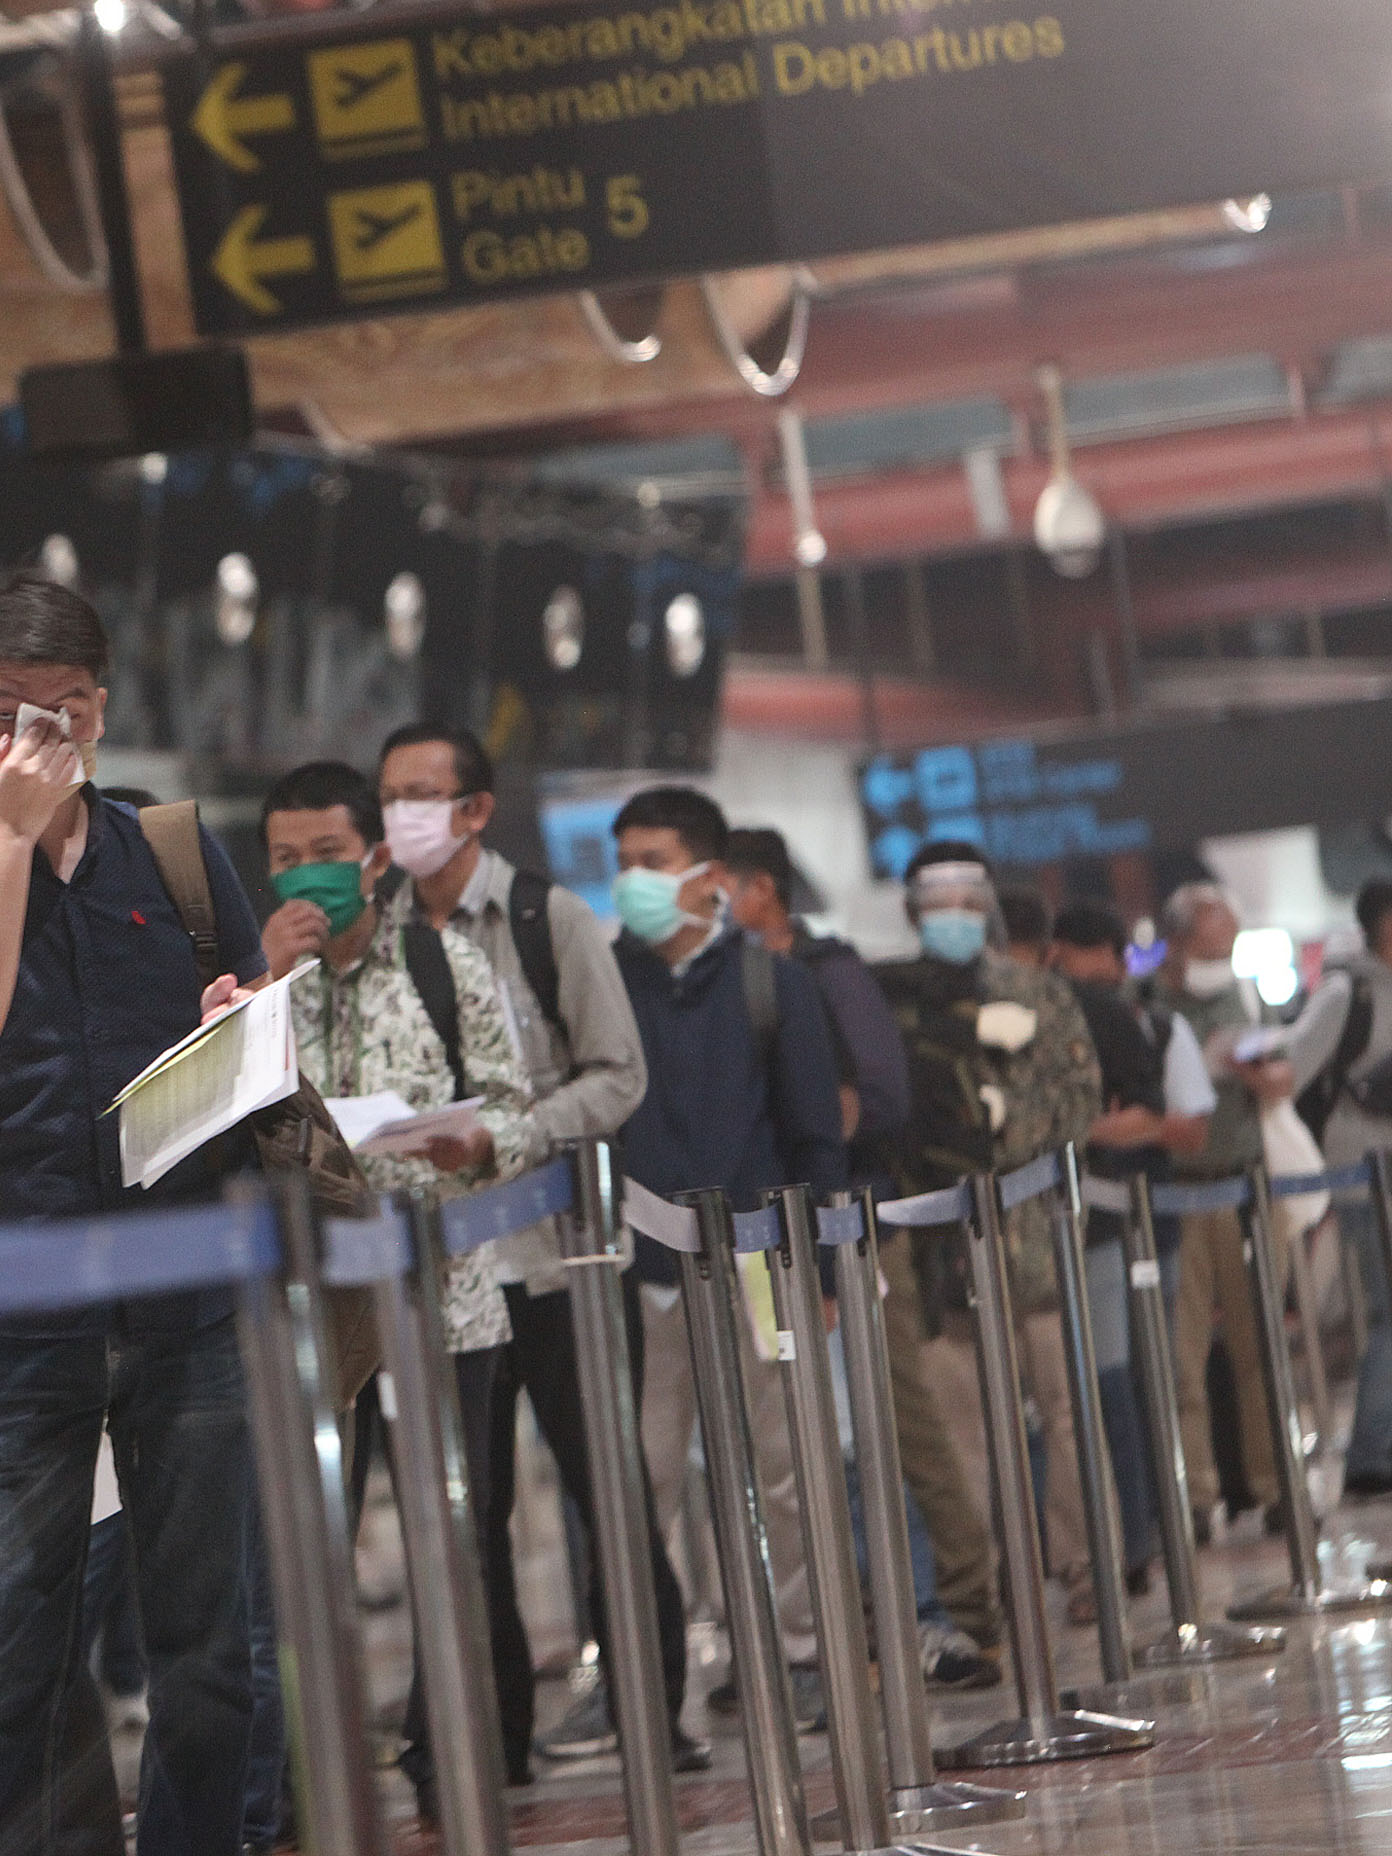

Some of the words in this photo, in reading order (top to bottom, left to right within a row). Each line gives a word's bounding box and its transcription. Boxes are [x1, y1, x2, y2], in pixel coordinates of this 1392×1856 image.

[431, 0, 827, 79] Keberangkatan
[441, 50, 758, 139] International
[772, 16, 1064, 96] Departures
[452, 167, 586, 218] Pintu
[607, 175, 649, 239] 5
[463, 225, 590, 285] Gate
